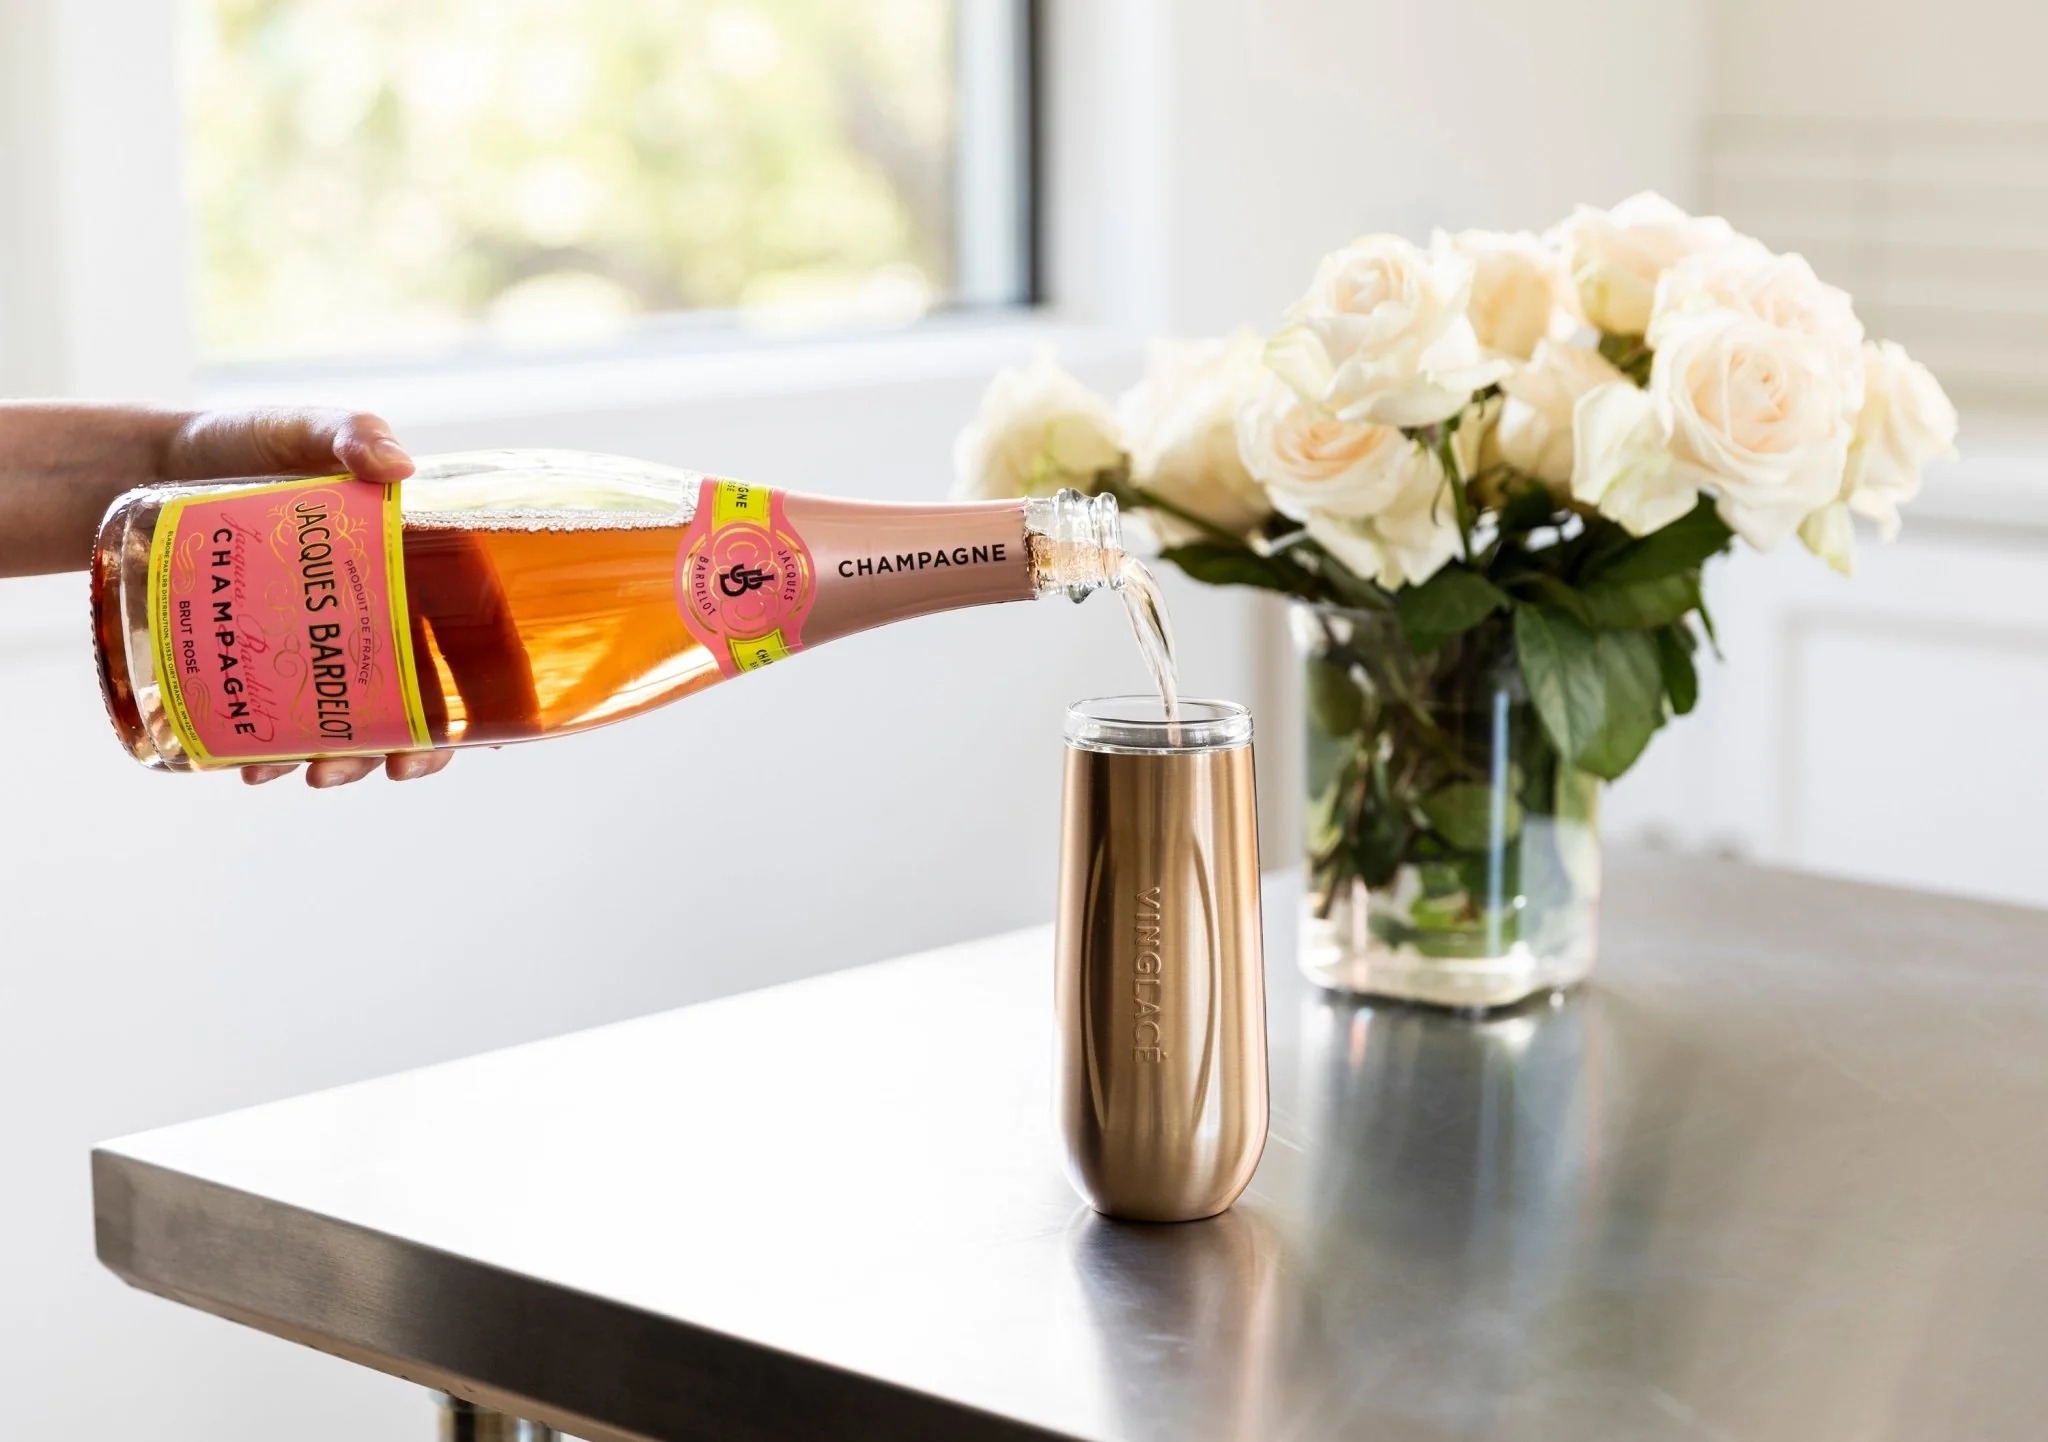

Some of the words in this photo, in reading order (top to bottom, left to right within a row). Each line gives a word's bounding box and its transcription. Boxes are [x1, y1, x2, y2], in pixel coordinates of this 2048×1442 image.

[295, 502, 338, 612] JACQUES
[778, 550, 797, 601] JACQUES
[838, 543, 1007, 579] CHAMPAGNE
[344, 559, 368, 612] PRODUIT
[695, 556, 717, 616] BARDELOT
[179, 600, 192, 635] BRUT
[211, 528, 256, 735] CHAMPAGNE
[361, 617, 370, 633] DE
[168, 663, 177, 679] OIRY
[183, 640, 200, 674] ROSÉ
[358, 638, 371, 685] FRANCE
[172, 681, 184, 706] FRANCE
[309, 624, 352, 741] BARDELOT
[1134, 886, 1168, 1064] VINGLACÉ
